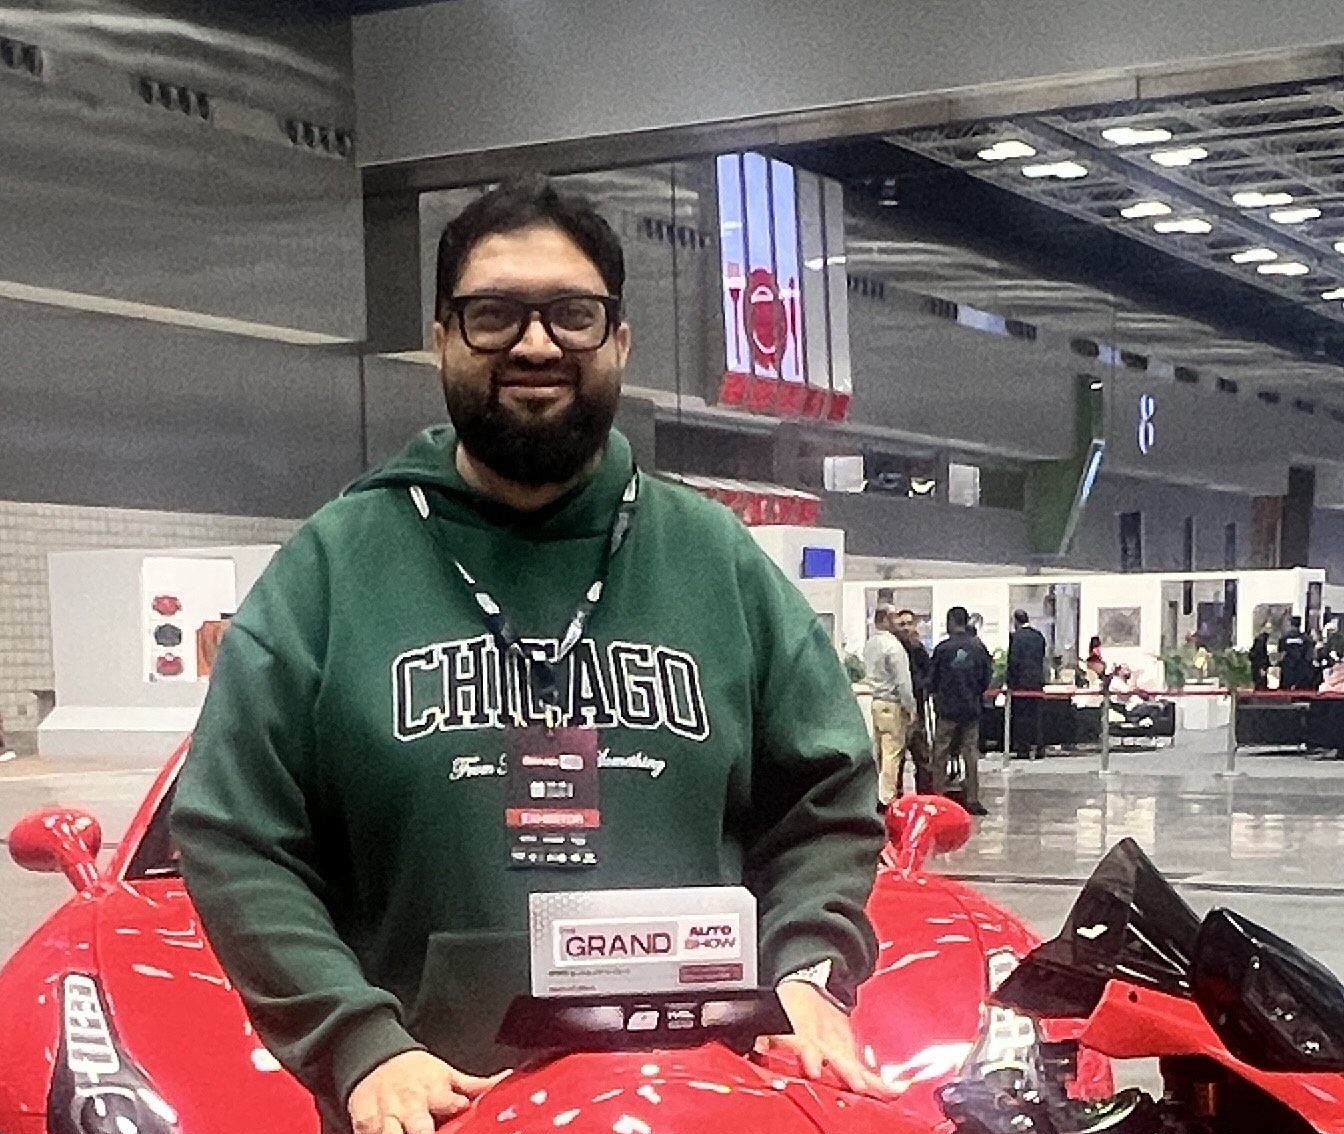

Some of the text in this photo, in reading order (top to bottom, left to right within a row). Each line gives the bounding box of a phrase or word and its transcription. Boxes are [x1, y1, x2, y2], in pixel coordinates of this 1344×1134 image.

[392, 634, 710, 741] CHICAGO
[688, 924, 732, 937] AUTO
[565, 931, 672, 958] GRAND
[684, 936, 737, 950] SHOW
